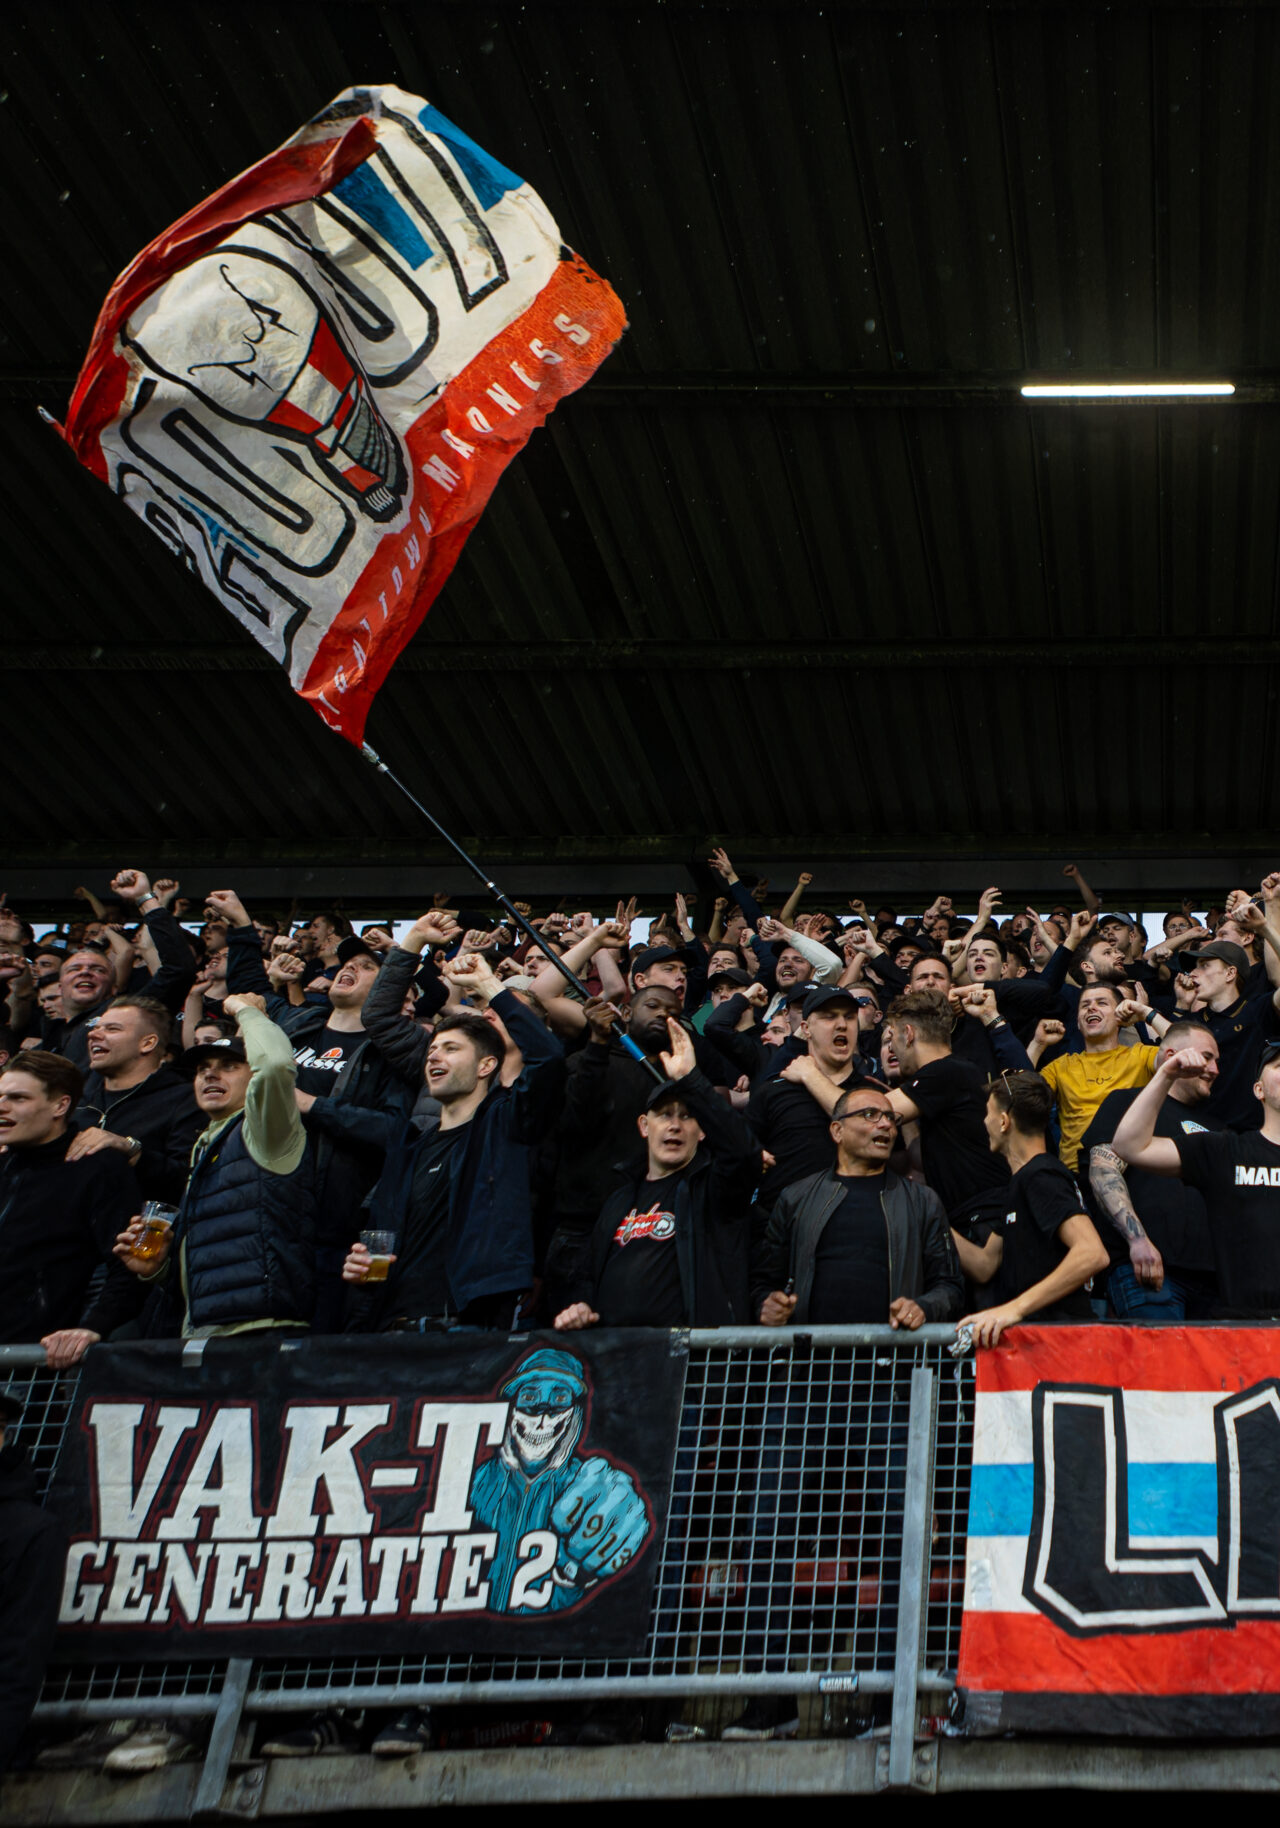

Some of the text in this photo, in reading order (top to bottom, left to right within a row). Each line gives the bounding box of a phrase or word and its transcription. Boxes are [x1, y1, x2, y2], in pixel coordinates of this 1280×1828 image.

[421, 311, 592, 493] MADNESS
[292, 1045, 348, 1073] llesse
[88, 1401, 511, 1541] VAK-T
[57, 1529, 559, 1625] GENERATIE 2
